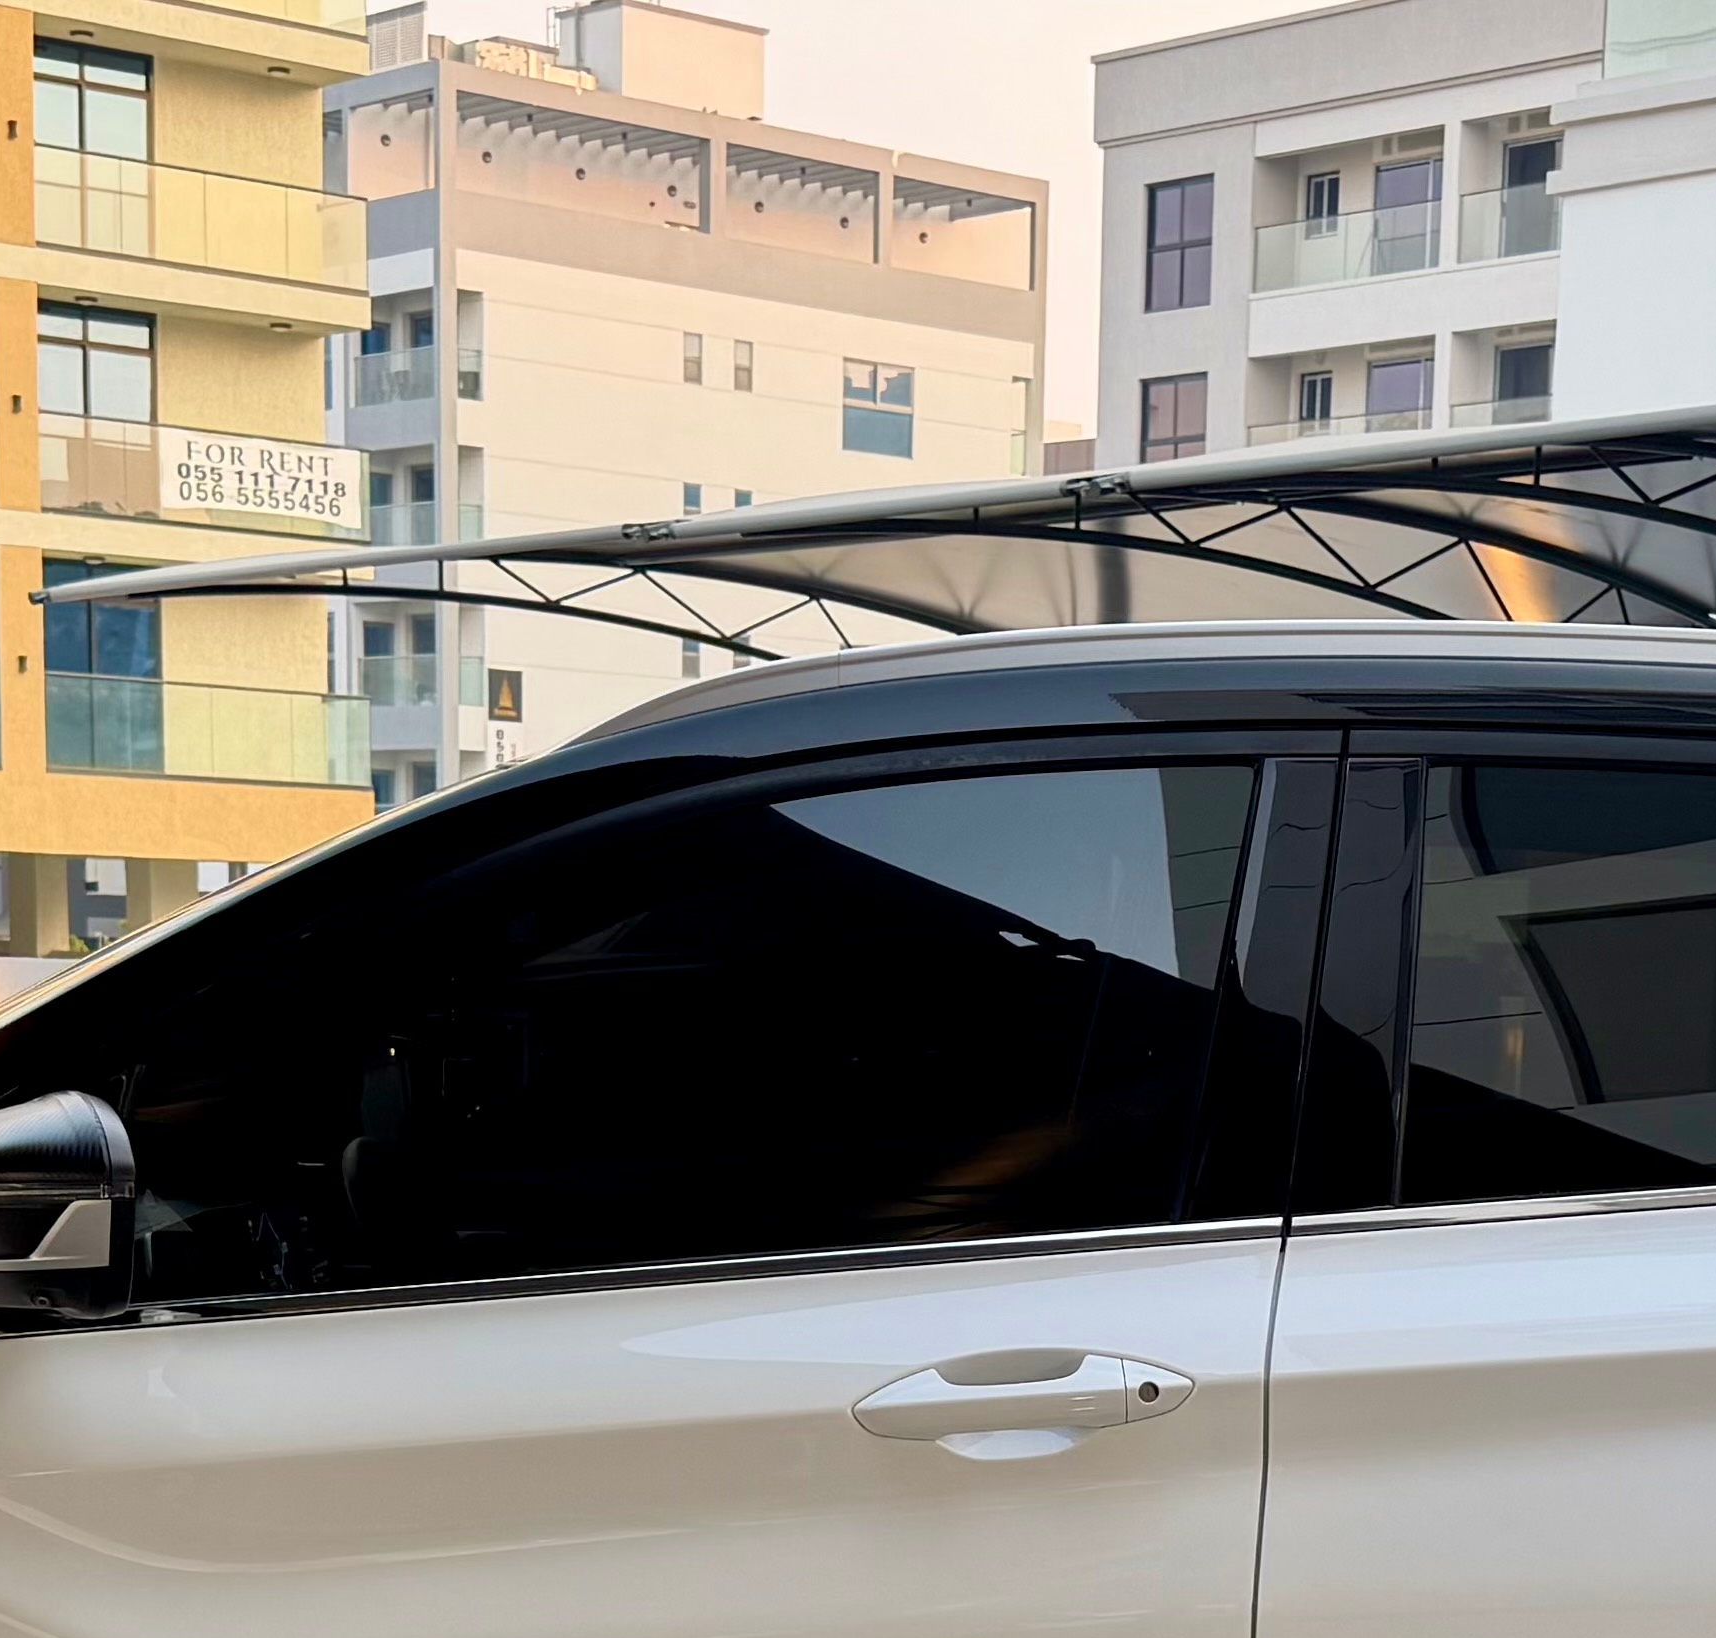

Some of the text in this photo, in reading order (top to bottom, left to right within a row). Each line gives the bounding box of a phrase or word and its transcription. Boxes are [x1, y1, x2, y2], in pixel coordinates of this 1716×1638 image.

[186, 440, 334, 477] FOR RENT
[177, 463, 346, 498] 055 111 7118
[179, 481, 342, 517] 056 5555456
